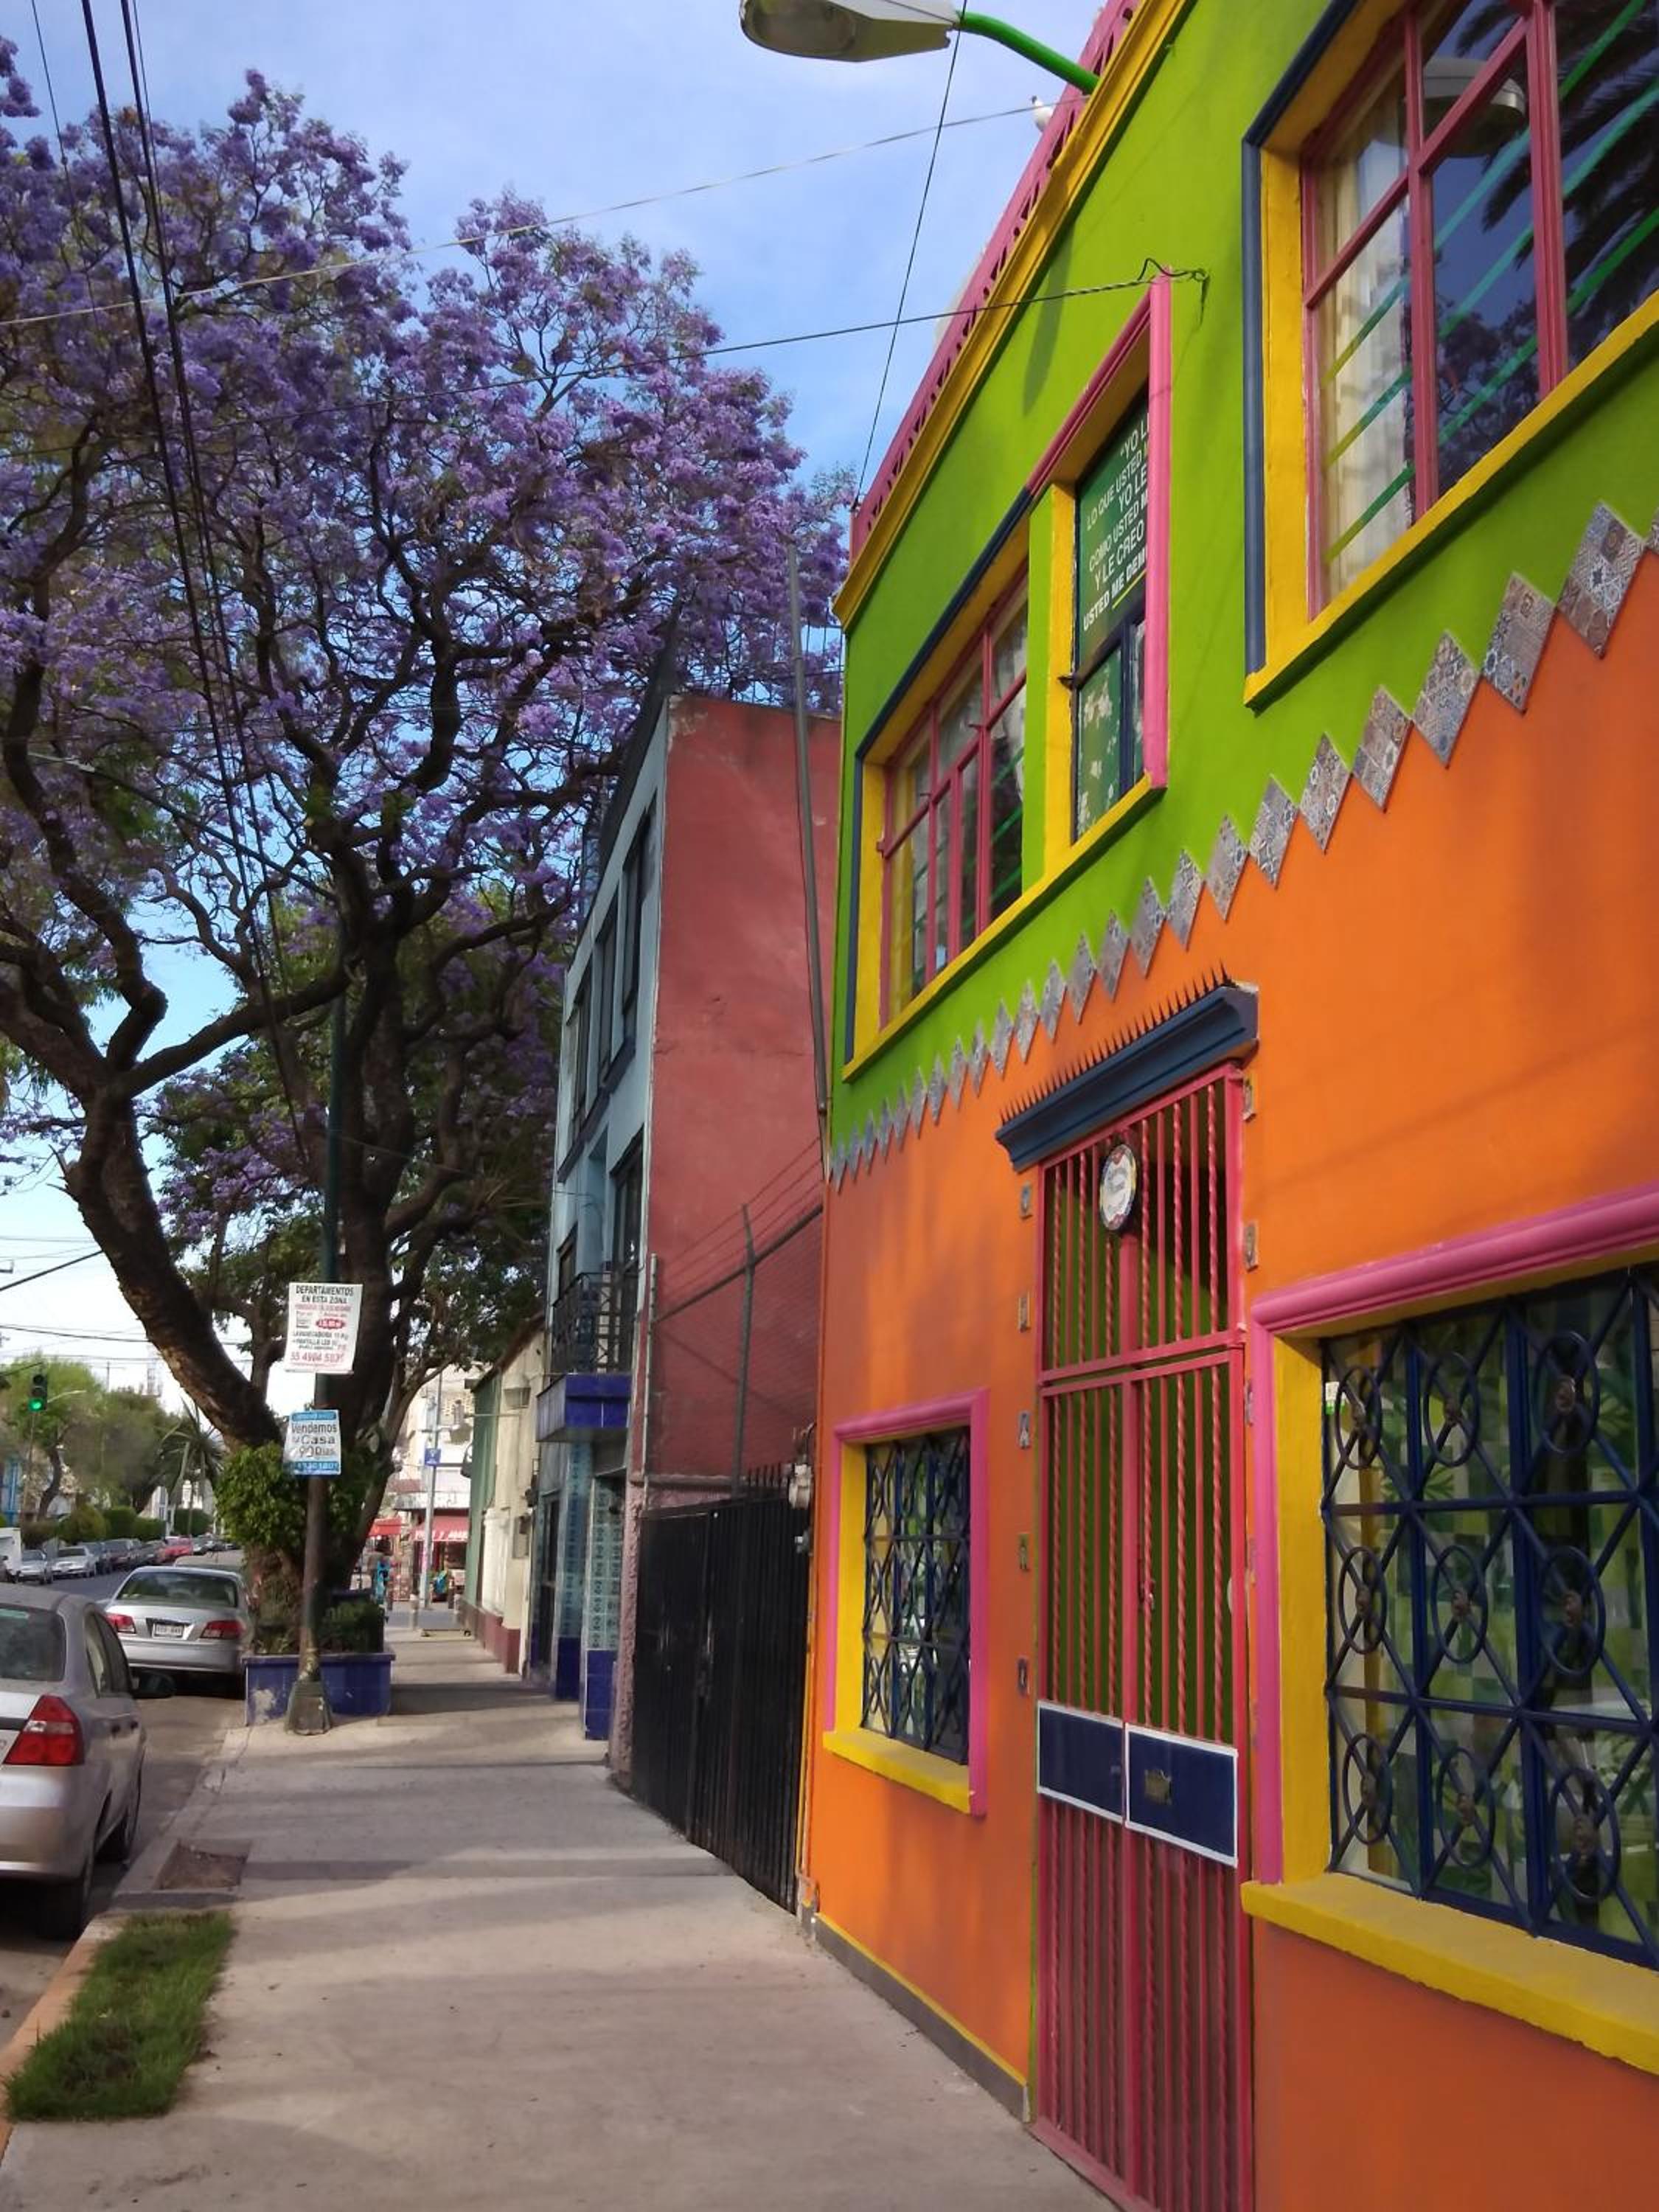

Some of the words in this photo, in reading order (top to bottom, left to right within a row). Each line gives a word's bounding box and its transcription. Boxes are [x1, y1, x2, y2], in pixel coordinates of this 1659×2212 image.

[1087, 507, 1098, 531] LO
[1098, 484, 1114, 516] QUE
[1116, 449, 1142, 493] USTED
[1119, 483, 1133, 512] YO
[1135, 463, 1147, 495] LE
[1089, 534, 1112, 572] COMO
[1113, 500, 1139, 543] USTED
[1116, 518, 1144, 566] CREO
[1083, 590, 1110, 632] USTED
[1111, 571, 1124, 599] ME
[296, 1285, 354, 1296] DEPARTAMENTOS
[302, 1295, 310, 1303] EN
[302, 1435, 335, 1444] Casa
